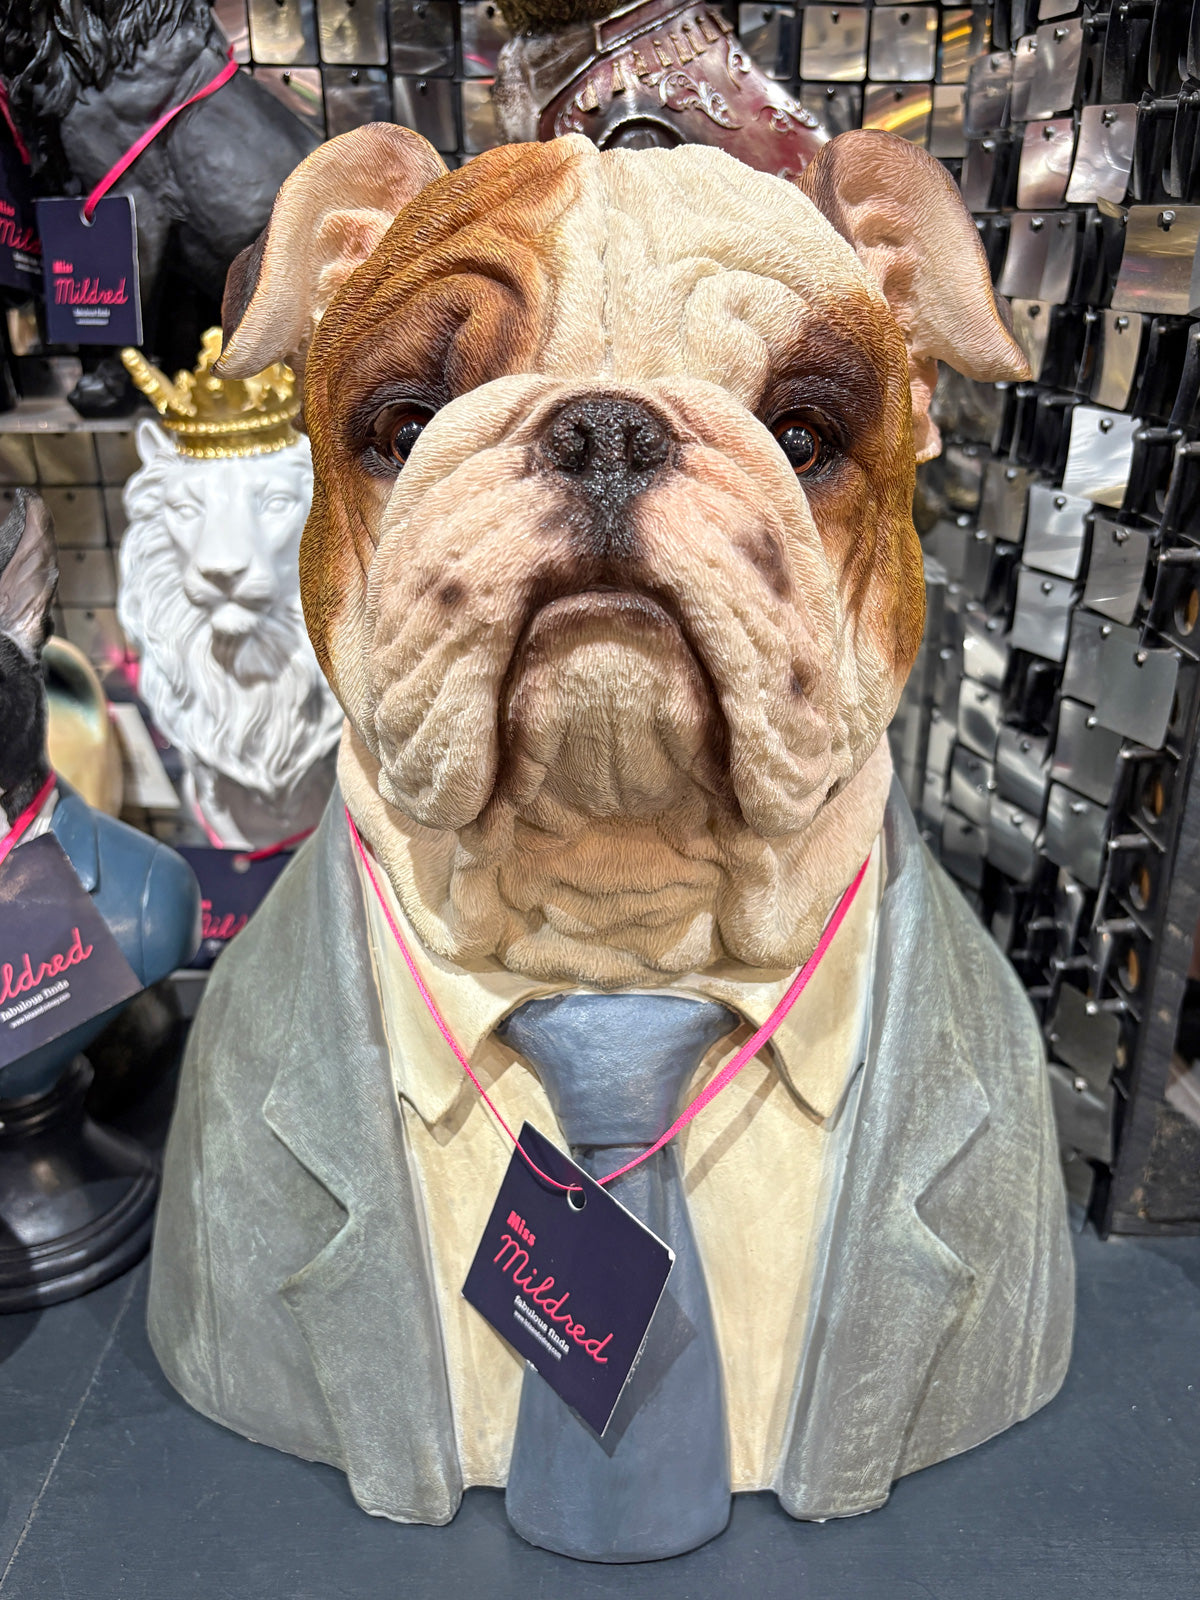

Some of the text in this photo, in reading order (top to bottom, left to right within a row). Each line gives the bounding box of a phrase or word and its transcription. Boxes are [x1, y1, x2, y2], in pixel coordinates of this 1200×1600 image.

[54, 276, 129, 305] Mildred
[0, 927, 93, 1005] ldred
[506, 1210, 536, 1247] Miss
[493, 1234, 614, 1363] Mildred
[514, 1294, 570, 1355] fabulous finds
